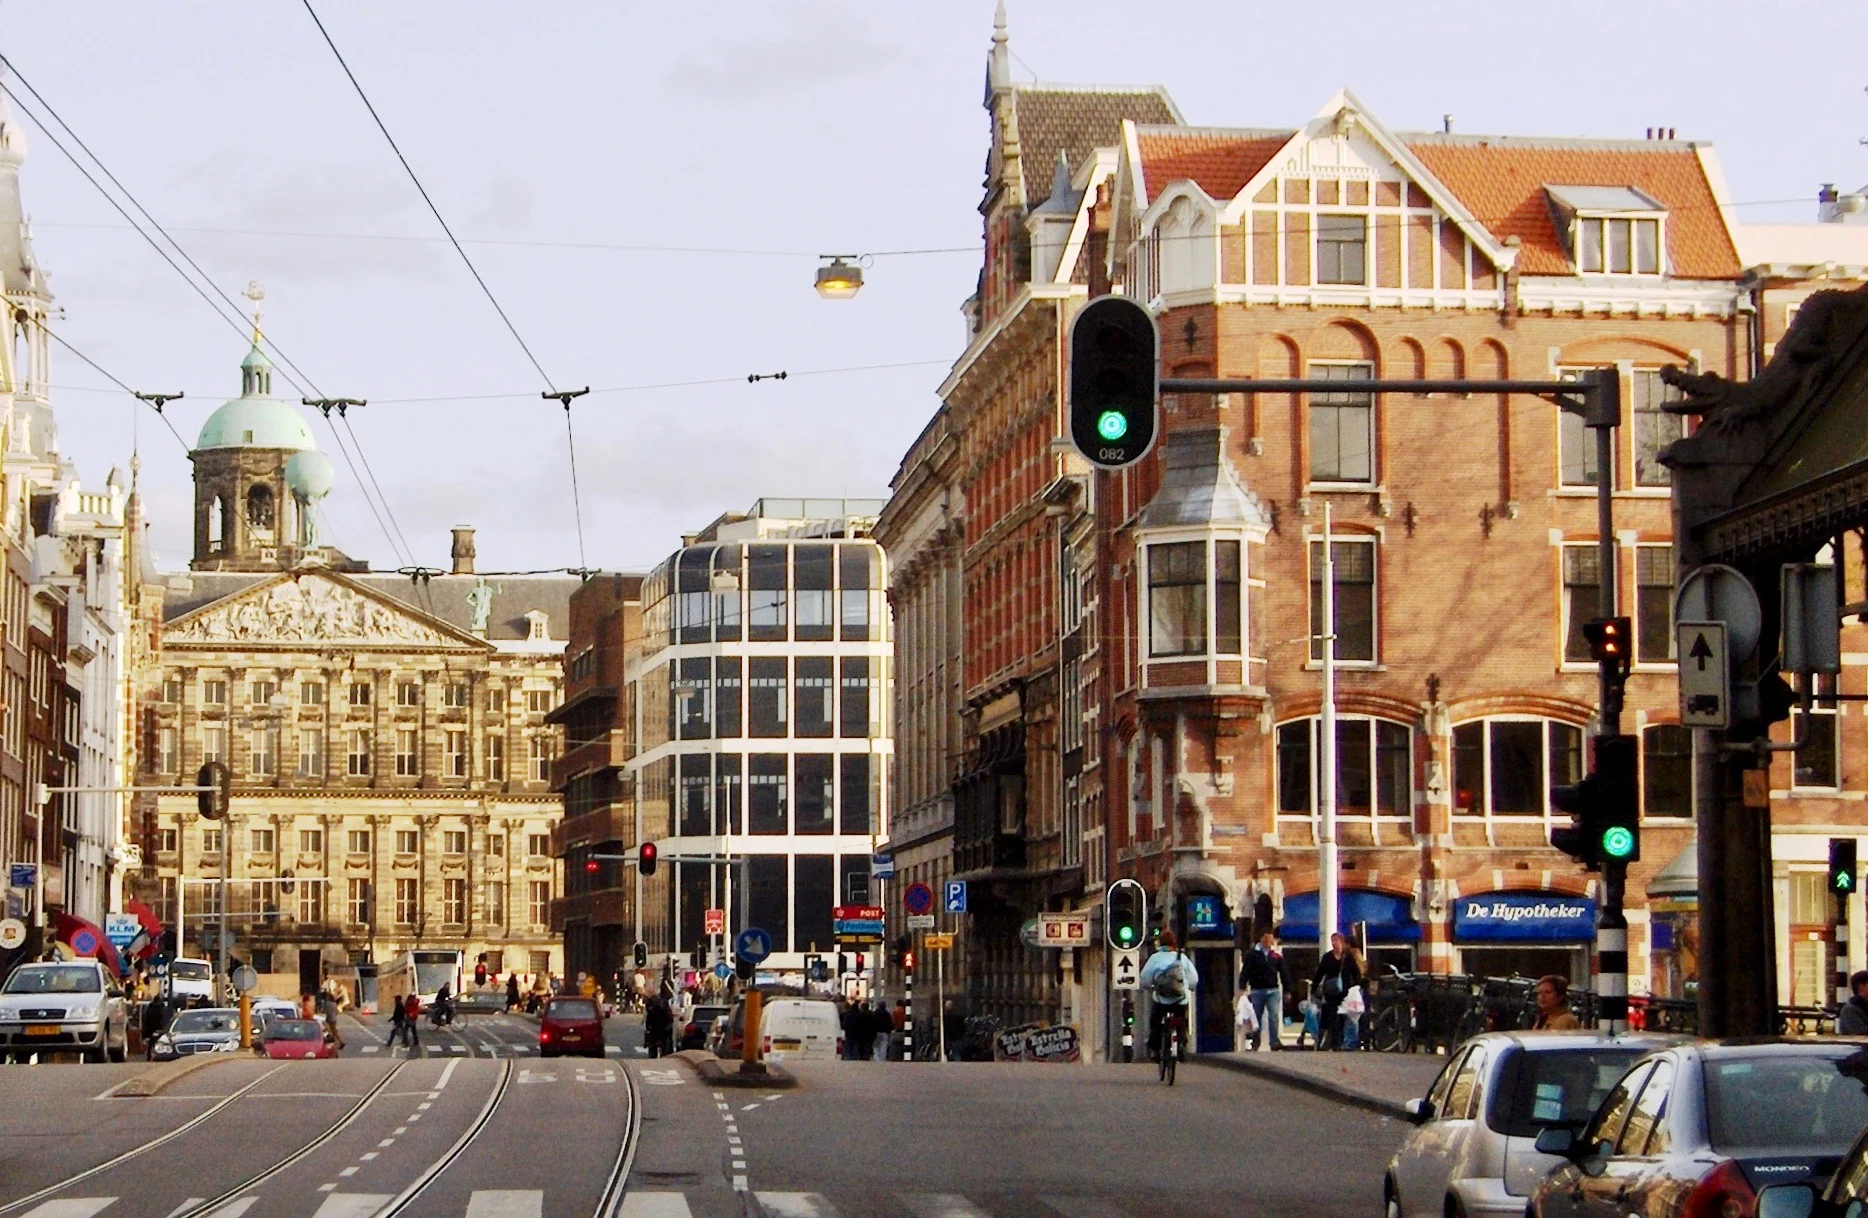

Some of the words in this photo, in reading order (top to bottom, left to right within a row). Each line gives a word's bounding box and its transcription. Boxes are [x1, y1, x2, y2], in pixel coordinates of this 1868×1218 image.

[1099, 447, 1125, 460] 082
[949, 884, 961, 900] P
[860, 909, 880, 917] POST
[1466, 903, 1489, 918] De
[1490, 903, 1586, 920] Hypotheker
[108, 925, 135, 933] KLM
